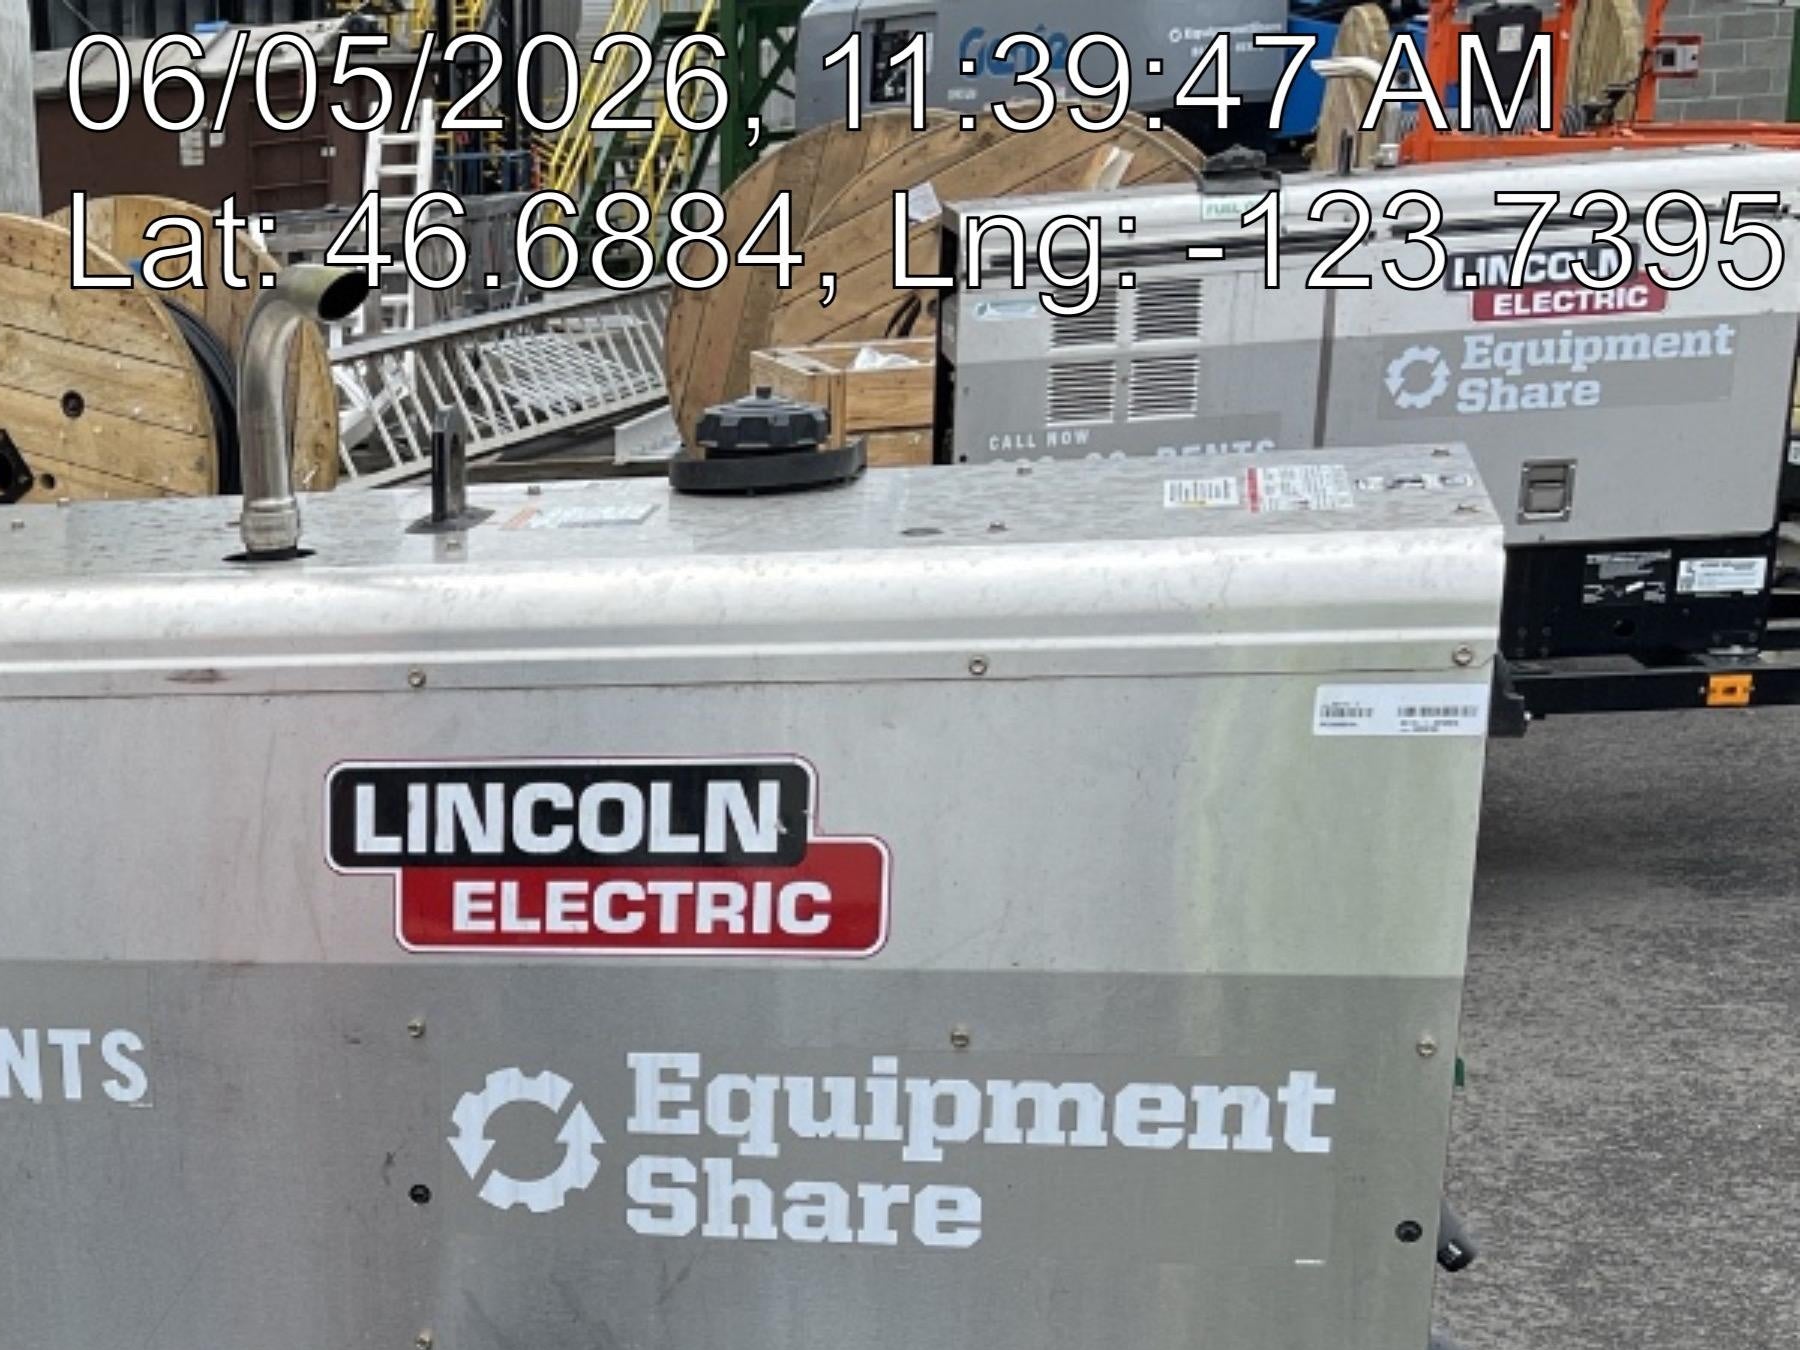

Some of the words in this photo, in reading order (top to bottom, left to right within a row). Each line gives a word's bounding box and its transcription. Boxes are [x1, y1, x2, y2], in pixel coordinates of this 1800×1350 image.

[1453, 247, 1628, 286] LINCOLN
[1493, 285, 1648, 317] ELECTRIC
[1460, 322, 1737, 376] Equipment
[1455, 377, 1601, 414] Share
[988, 434, 1036, 451] CALL
[1046, 429, 1091, 447] NOW
[354, 779, 782, 854] LINCOLN
[451, 879, 832, 936] ELECTRIC
[626, 1051, 1336, 1163] Equipment
[625, 1155, 983, 1249] Share
